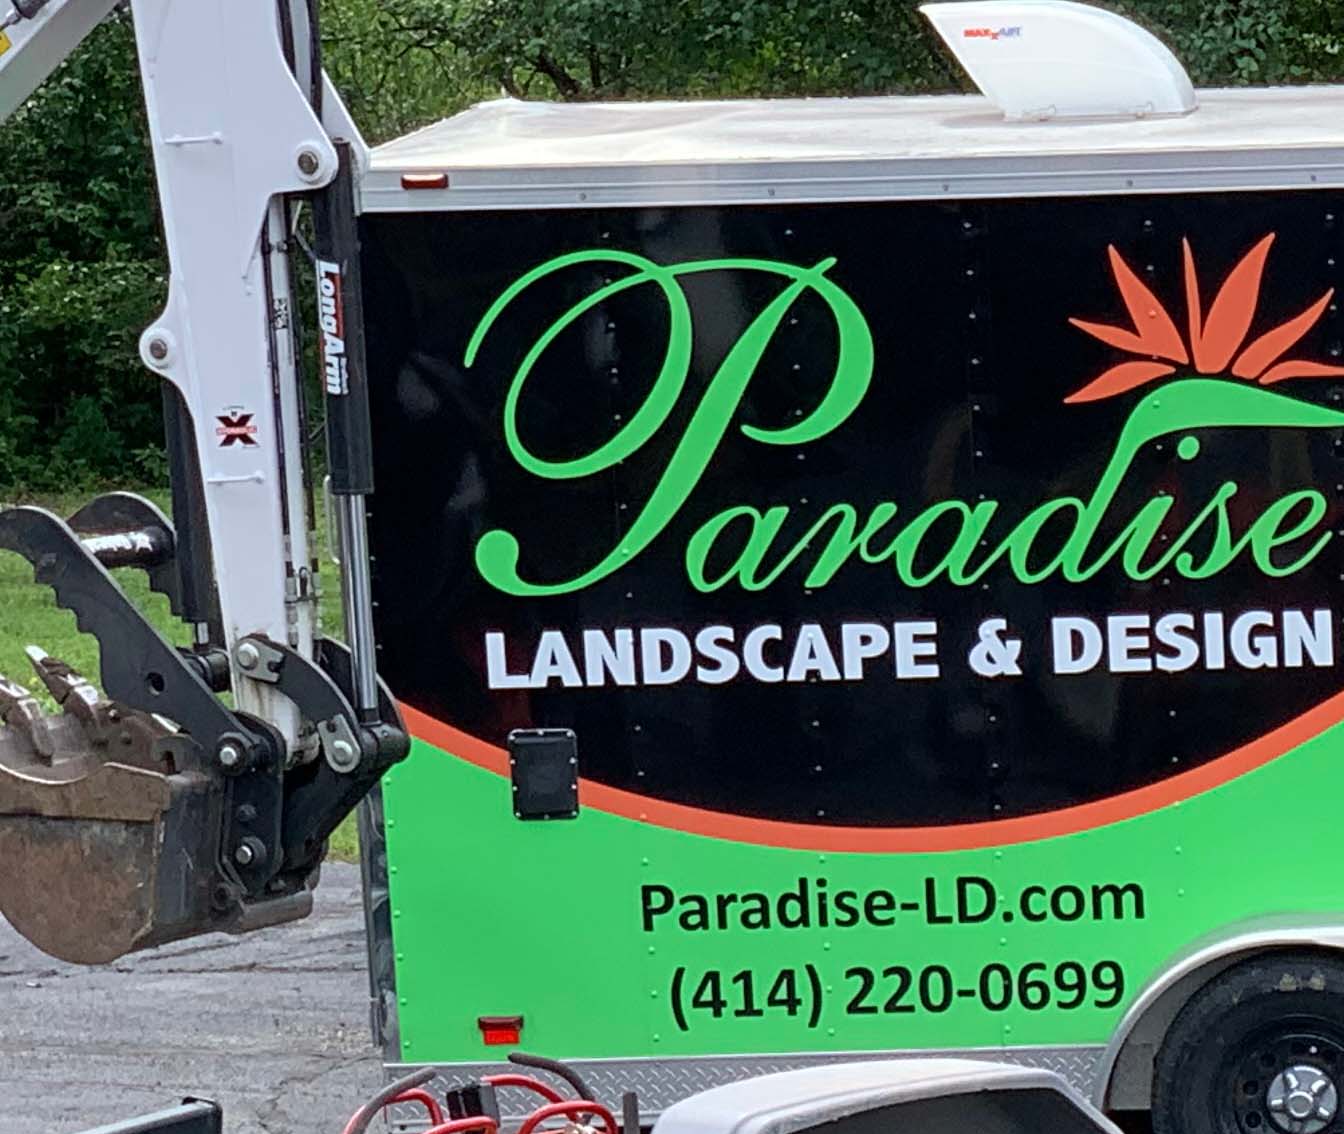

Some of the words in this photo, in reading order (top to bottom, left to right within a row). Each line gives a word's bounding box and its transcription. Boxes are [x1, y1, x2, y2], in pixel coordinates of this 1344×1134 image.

[318, 260, 345, 395] LongArm
[464, 249, 1336, 596] Paradise
[485, 621, 940, 691] LANDSCAPE
[967, 618, 1022, 677] &
[1051, 609, 1335, 676] DESIGN
[640, 876, 1146, 932] Paradise-LD.com
[670, 964, 823, 1031] (414)
[844, 960, 1125, 1016] 220-0699
